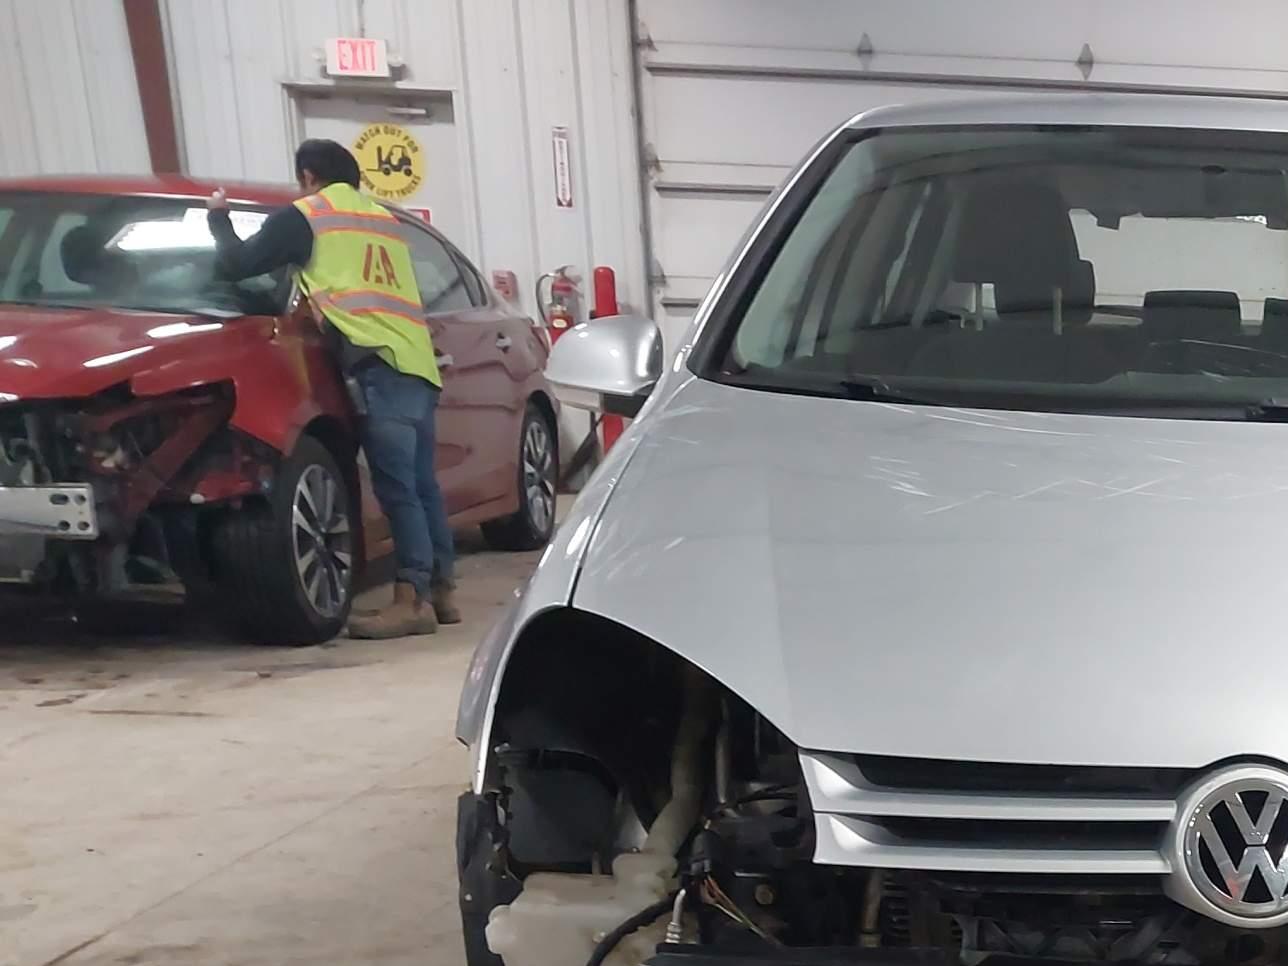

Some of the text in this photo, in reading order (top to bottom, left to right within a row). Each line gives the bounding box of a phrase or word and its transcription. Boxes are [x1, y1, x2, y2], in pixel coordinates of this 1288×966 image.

[337, 39, 376, 71] EXIT
[356, 125, 419, 153] WATCH OUT FOR
[395, 174, 422, 196] TRUCKS
